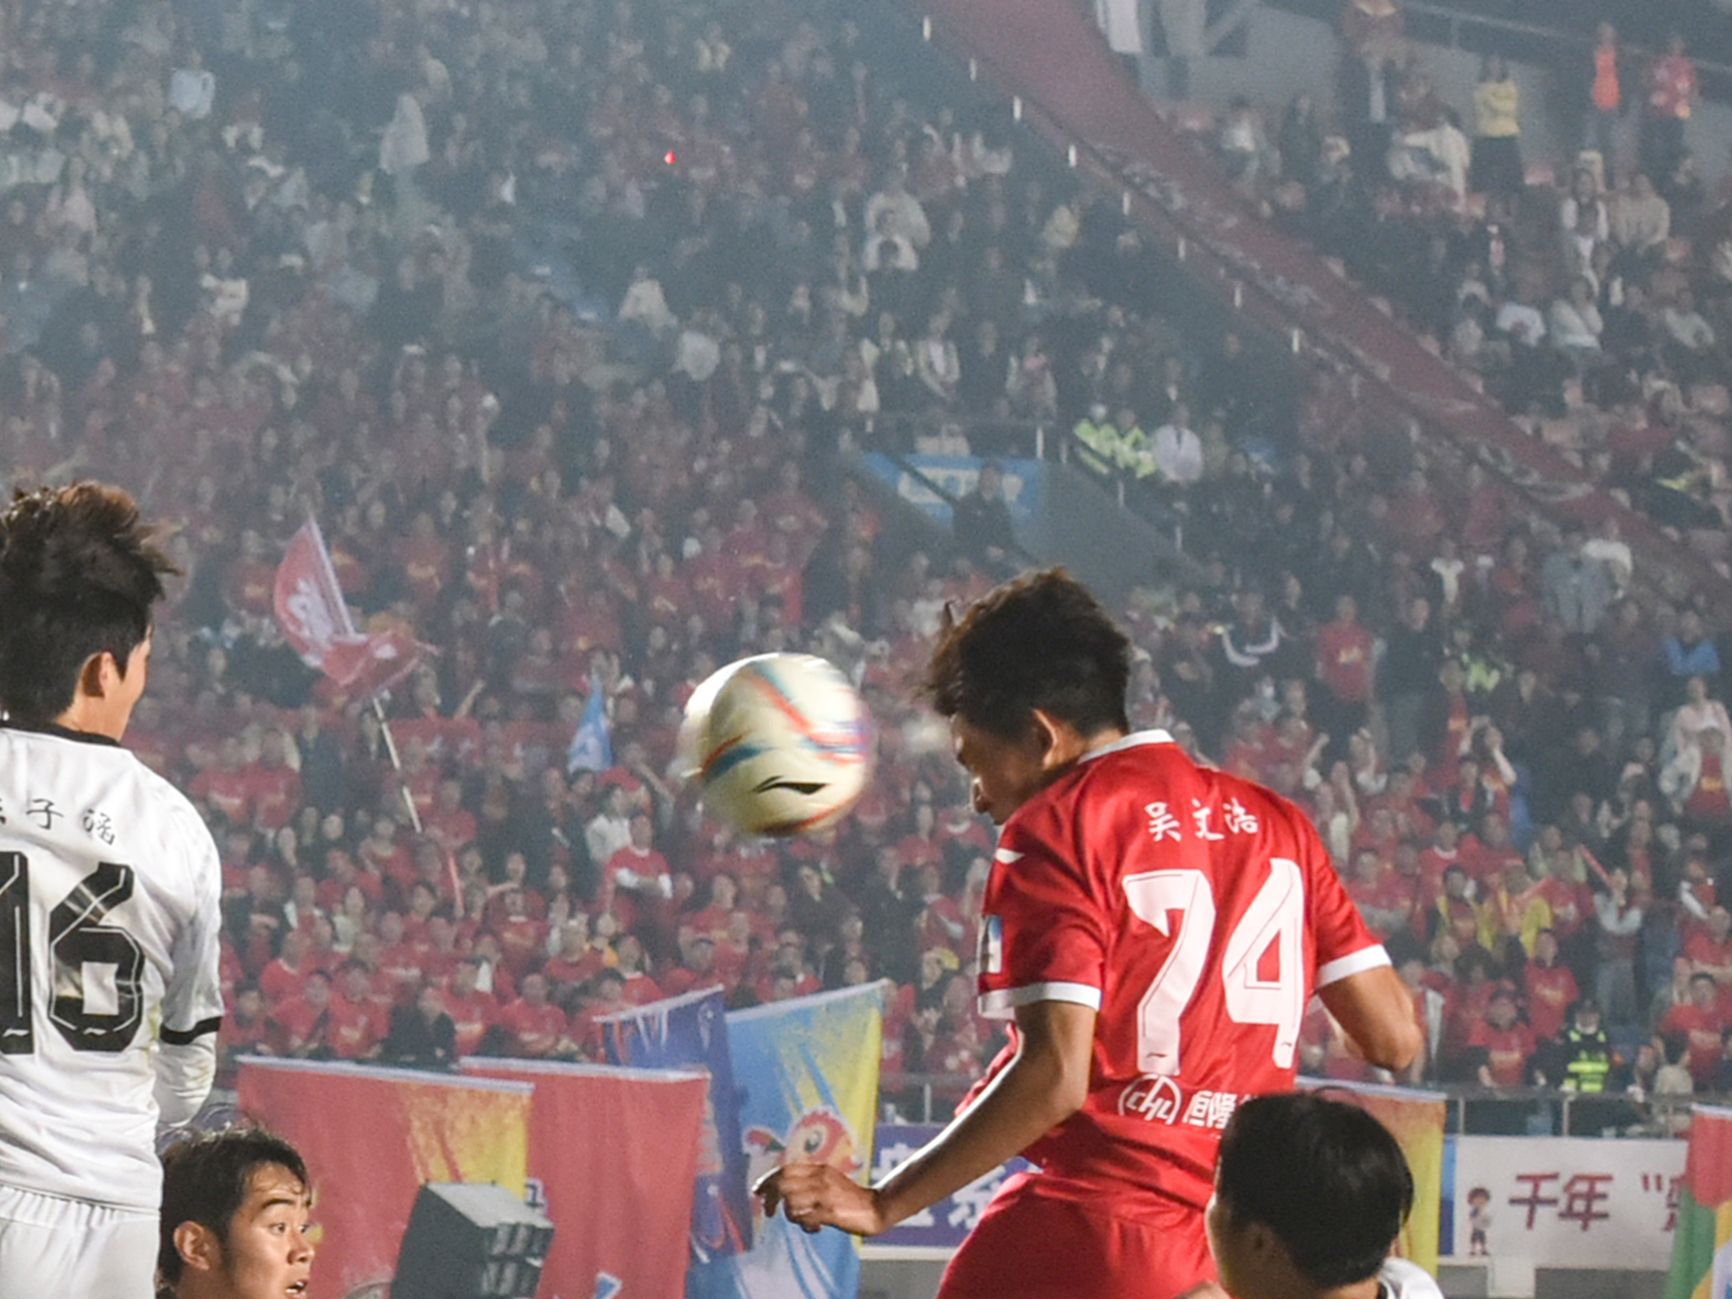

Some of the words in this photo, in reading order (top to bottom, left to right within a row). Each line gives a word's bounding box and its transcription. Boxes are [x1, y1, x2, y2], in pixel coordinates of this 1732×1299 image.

[0, 850, 146, 1053] 16
[1122, 857, 1303, 1076] 74
[1182, 1090, 1257, 1129] 恒隆
